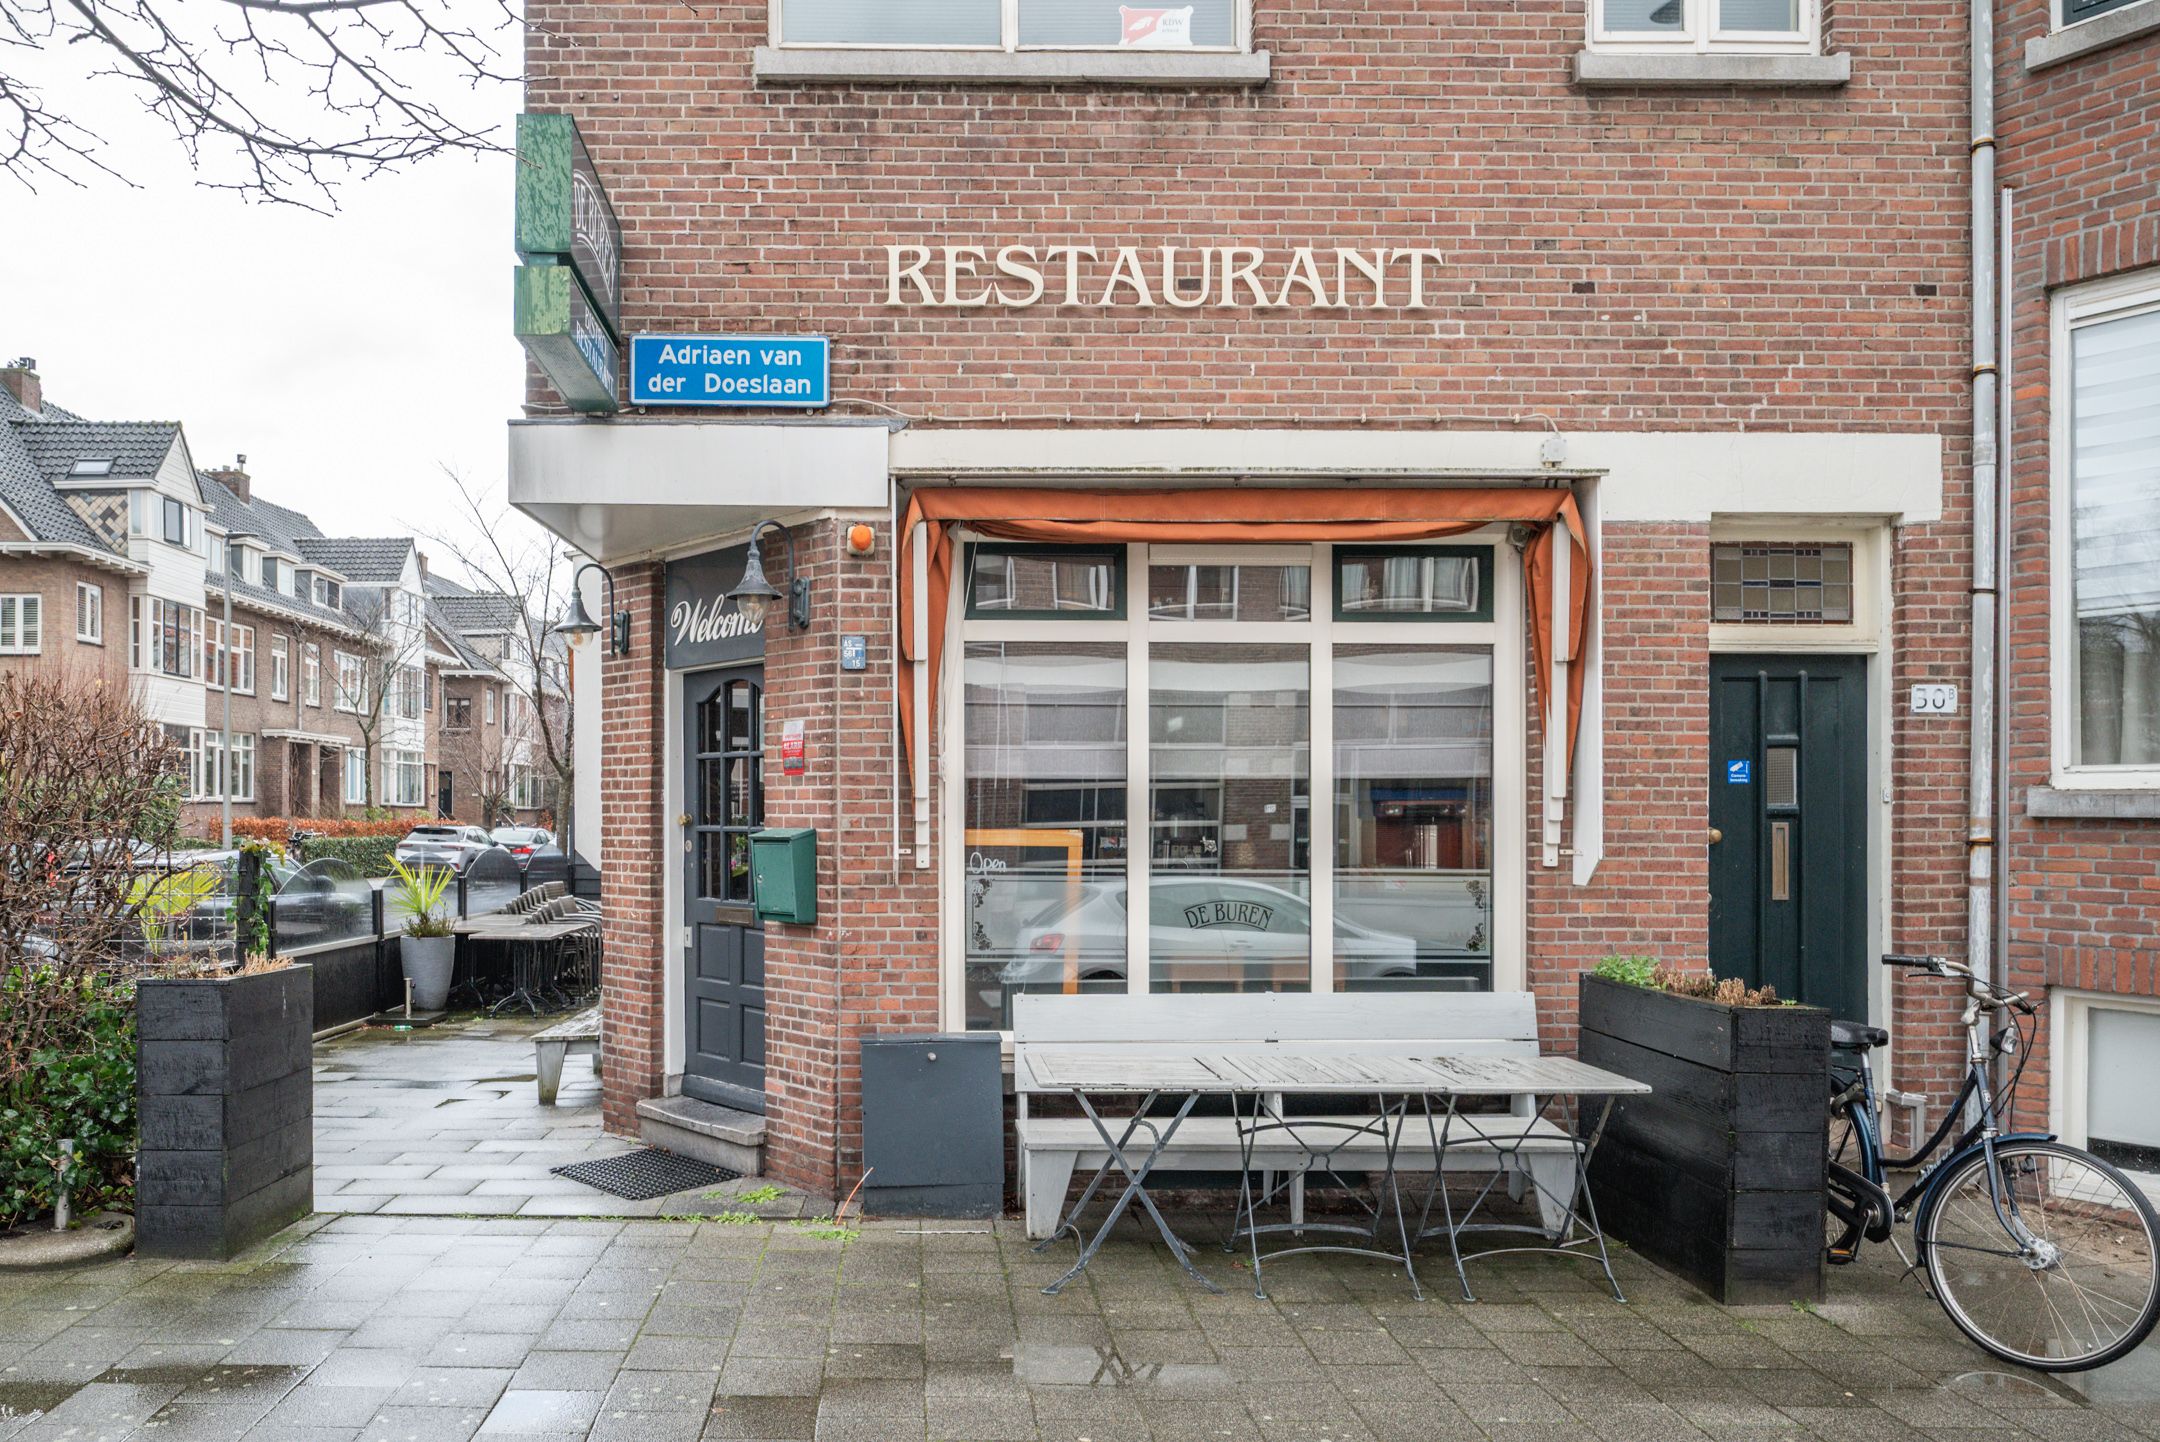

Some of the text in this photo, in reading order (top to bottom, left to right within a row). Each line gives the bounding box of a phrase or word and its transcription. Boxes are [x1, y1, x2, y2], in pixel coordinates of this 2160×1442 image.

[574, 181, 616, 284] DE BUREN
[883, 244, 1444, 308] RESTAURANT
[585, 306, 607, 357] BISTRO
[658, 344, 801, 366] Adriaen van
[576, 321, 615, 397] RESTAURANT
[648, 373, 811, 394] der Doeslaan
[671, 594, 763, 646] Welcome
[970, 852, 1006, 876] Open
[1185, 903, 1272, 929] DE BUREN
